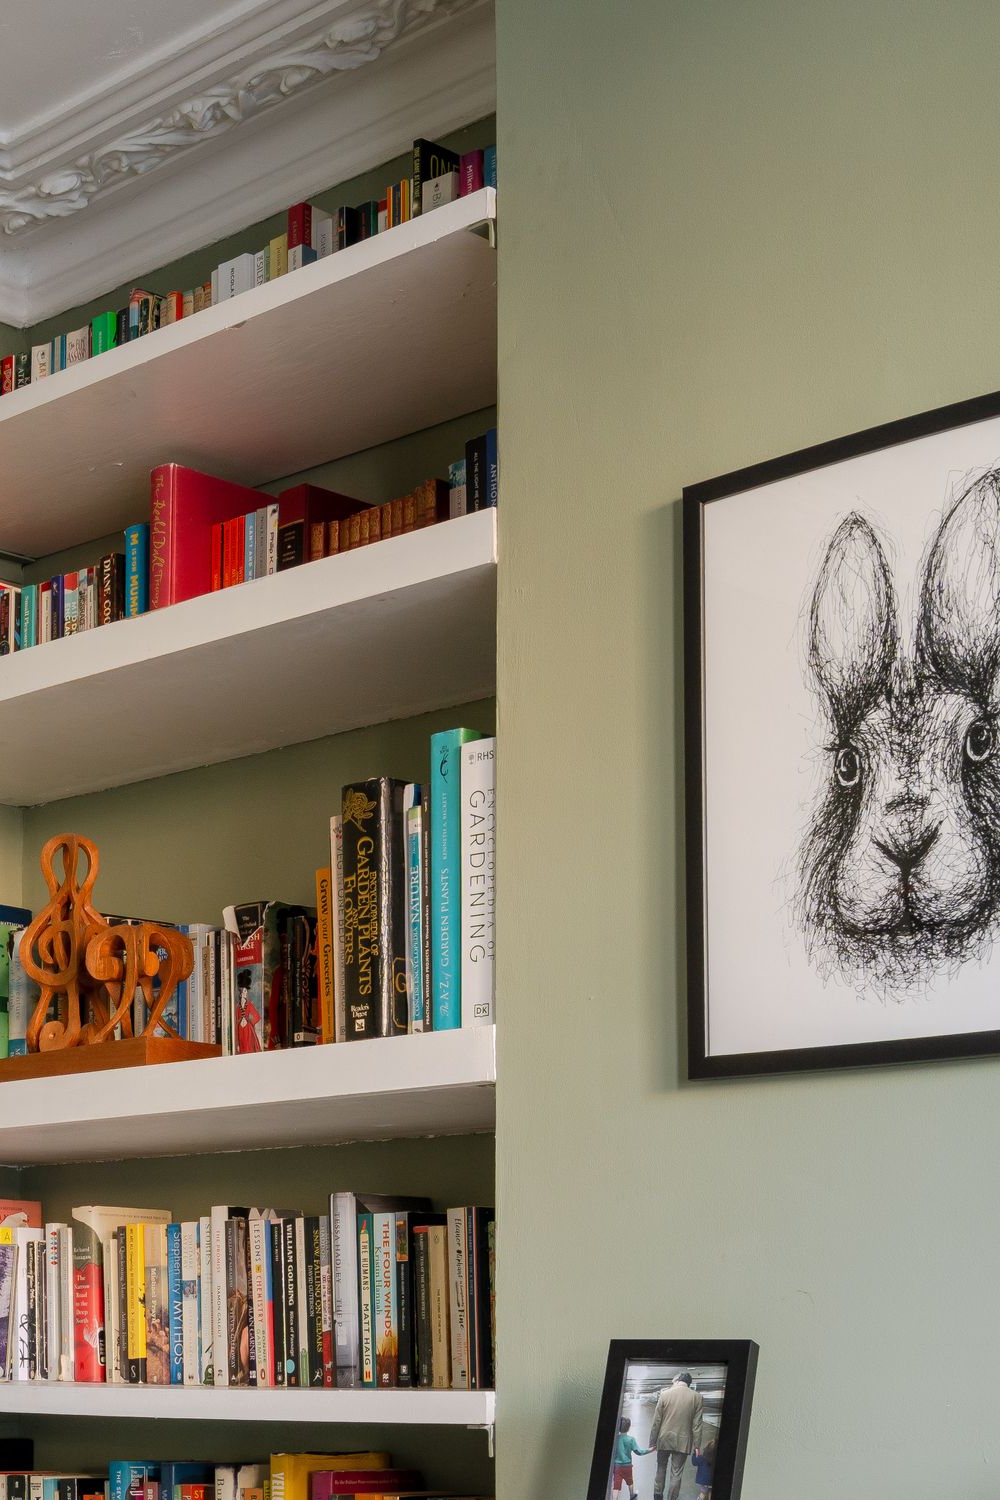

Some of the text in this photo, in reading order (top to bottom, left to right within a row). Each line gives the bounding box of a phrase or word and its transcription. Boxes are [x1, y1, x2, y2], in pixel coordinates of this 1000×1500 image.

[103, 559, 111, 597] DIANE
[477, 750, 495, 760] RHS
[411, 865, 420, 924] NATURE
[469, 790, 486, 963] GARDENING
[486, 788, 496, 960] ENCYCLOPEDIA OF
[319, 879, 328, 913] Grow
[356, 836, 374, 995] GARDEN PLANTS
[440, 868, 450, 966] GARDEN PLANTS
[344, 876, 355, 965] FLOWERS
[323, 943, 331, 997] Groceries
[371, 944, 377, 956] OF
[475, 1006, 488, 1016] DK
[312, 1229, 320, 1255] SNOW
[454, 1218, 462, 1247] Eleanor
[172, 1233, 181, 1276] Stephen
[253, 1223, 264, 1323] LESSONS CHEMISTRY
[286, 1224, 295, 1306] WILLIAM GOLDING
[313, 1259, 321, 1294] FALLING
[376, 1279, 384, 1315] Hannah
[382, 1222, 392, 1338] THE FOUR WINDS
[315, 1299, 322, 1312] ON
[174, 1301, 184, 1365] MYTHOS
[363, 1337, 371, 1366] HAIG
